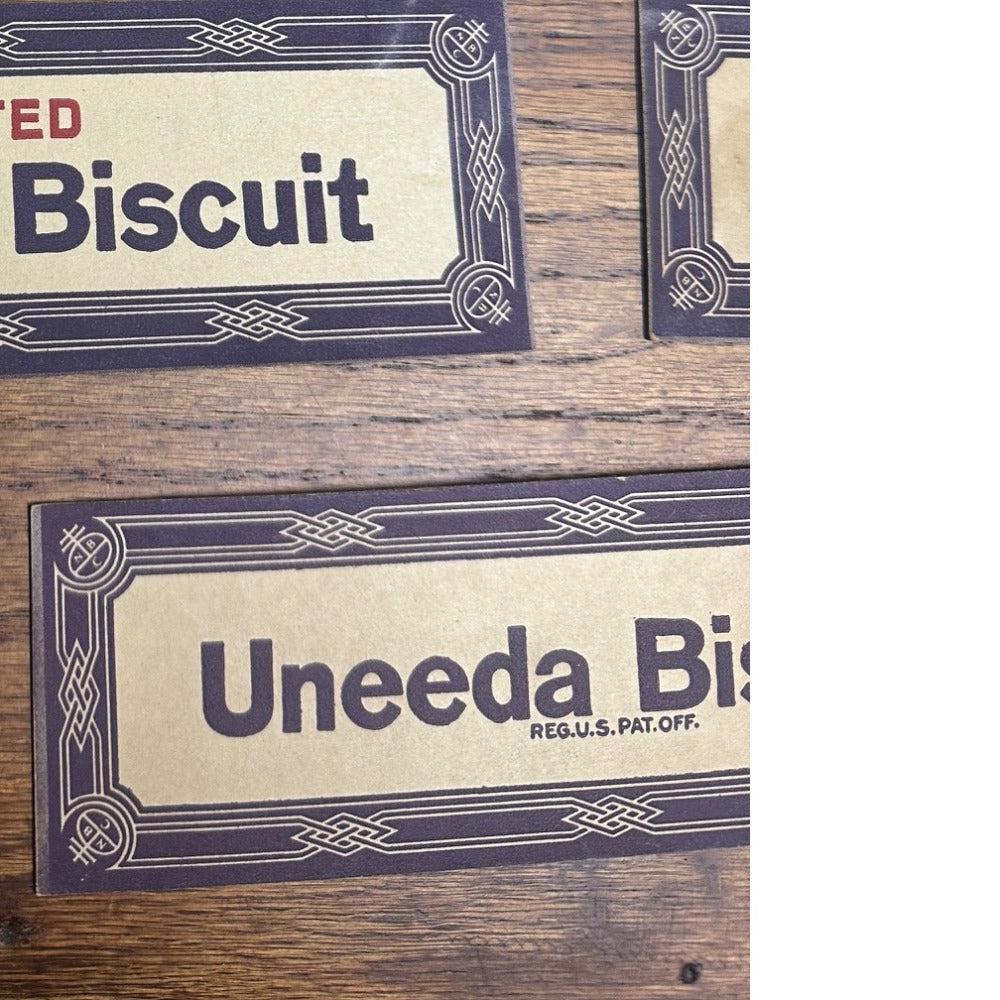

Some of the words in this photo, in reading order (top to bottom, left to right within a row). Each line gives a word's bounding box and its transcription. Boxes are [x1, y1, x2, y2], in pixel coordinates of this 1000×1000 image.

[11, 151, 374, 256] Biscuit
[200, 625, 593, 738] Uneeda
[634, 613, 750, 713] Bi
